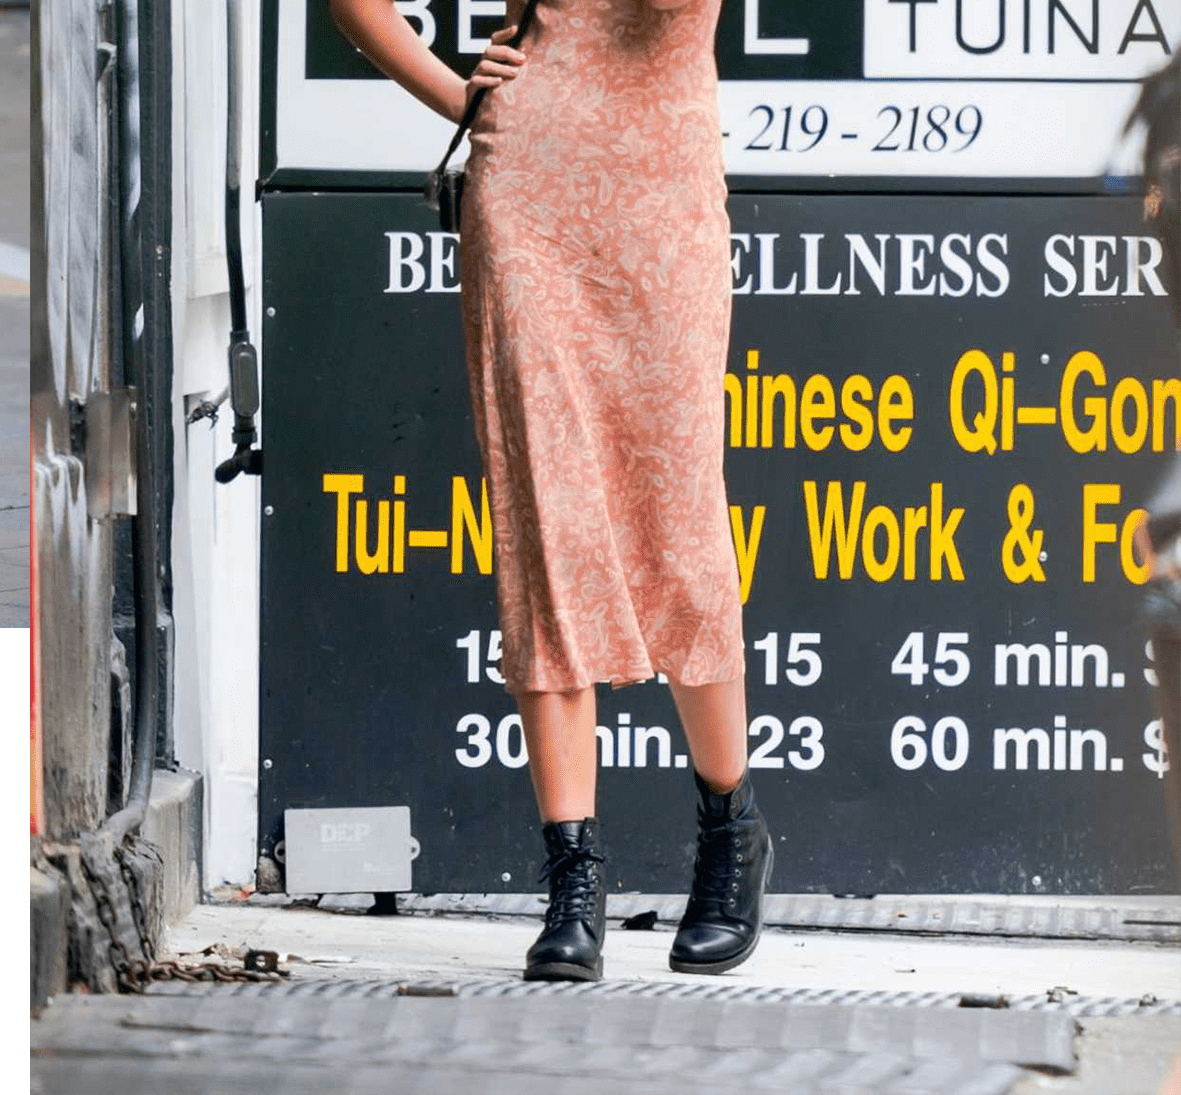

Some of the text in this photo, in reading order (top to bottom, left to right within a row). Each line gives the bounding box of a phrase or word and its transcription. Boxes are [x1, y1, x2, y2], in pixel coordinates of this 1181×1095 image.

[744, 104, 829, 152] 219
[871, 104, 983, 153] 2189
[728, 232, 1011, 297] ELLNESS
[803, 480, 966, 583] Work
[1002, 483, 1047, 584] &
[753, 631, 823, 687] 15
[891, 632, 971, 687] 45
[994, 630, 1126, 689] min.
[455, 713, 530, 769] 30
[890, 715, 970, 771] 60
[992, 714, 1124, 772] min.
